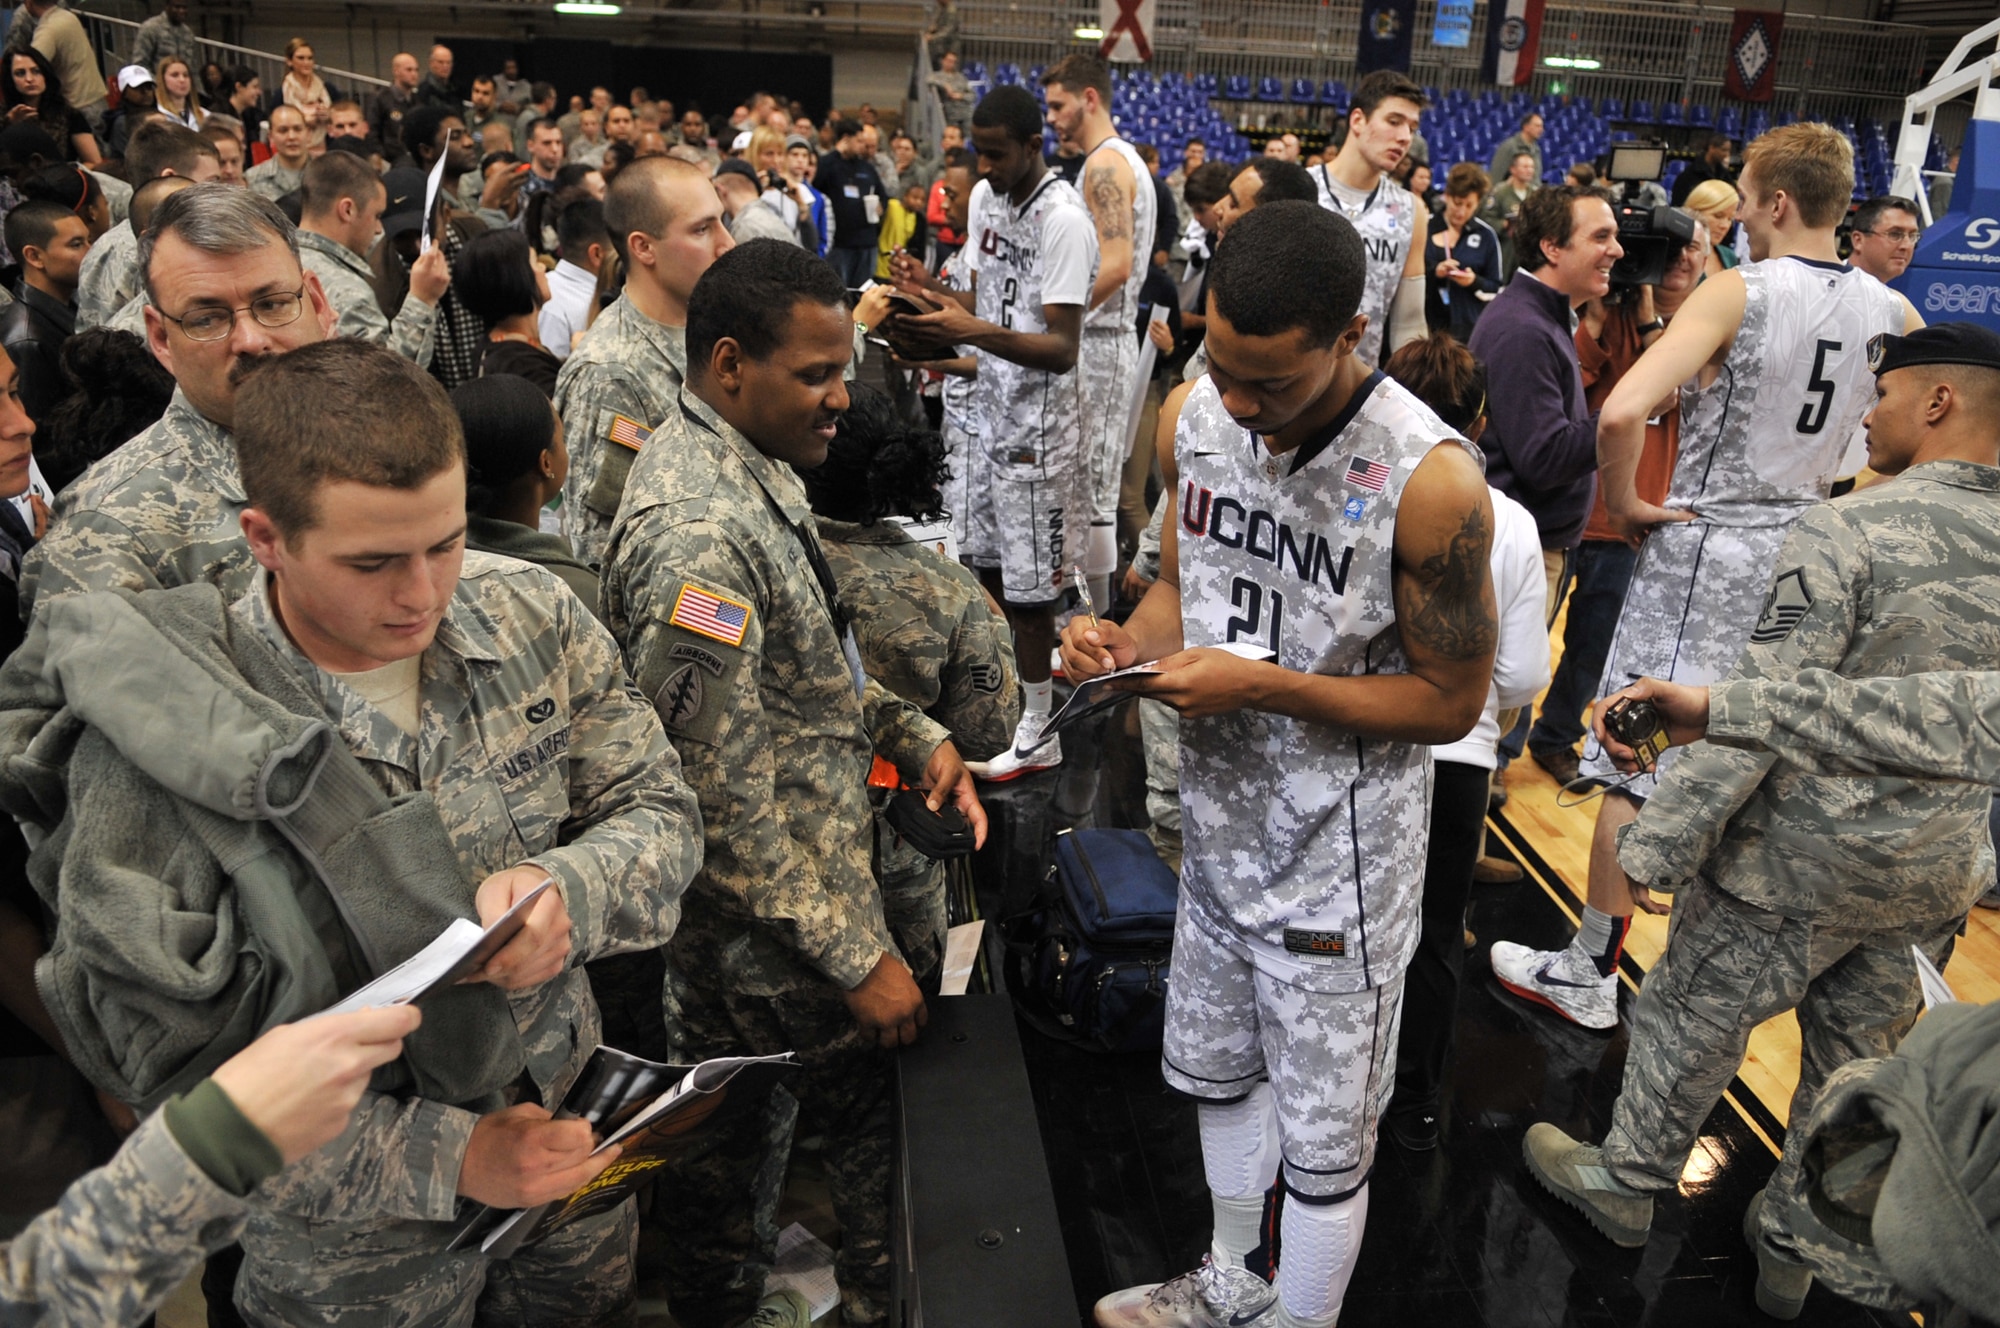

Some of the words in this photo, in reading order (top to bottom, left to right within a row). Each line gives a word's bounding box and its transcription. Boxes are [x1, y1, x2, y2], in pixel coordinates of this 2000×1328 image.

[980, 227, 1036, 271] UCONN
[1002, 278, 1017, 331] 2
[1796, 338, 1842, 435] 5
[1048, 507, 1064, 587] UCONN
[1183, 480, 1355, 597] UCONN
[1226, 576, 1284, 666] 21
[675, 647, 722, 672] AIRBORNE
[503, 752, 537, 779] U.S.
[1311, 932, 1344, 943] NIKE
[1311, 941, 1345, 952] ELITE
[599, 1159, 666, 1179] STUFF
